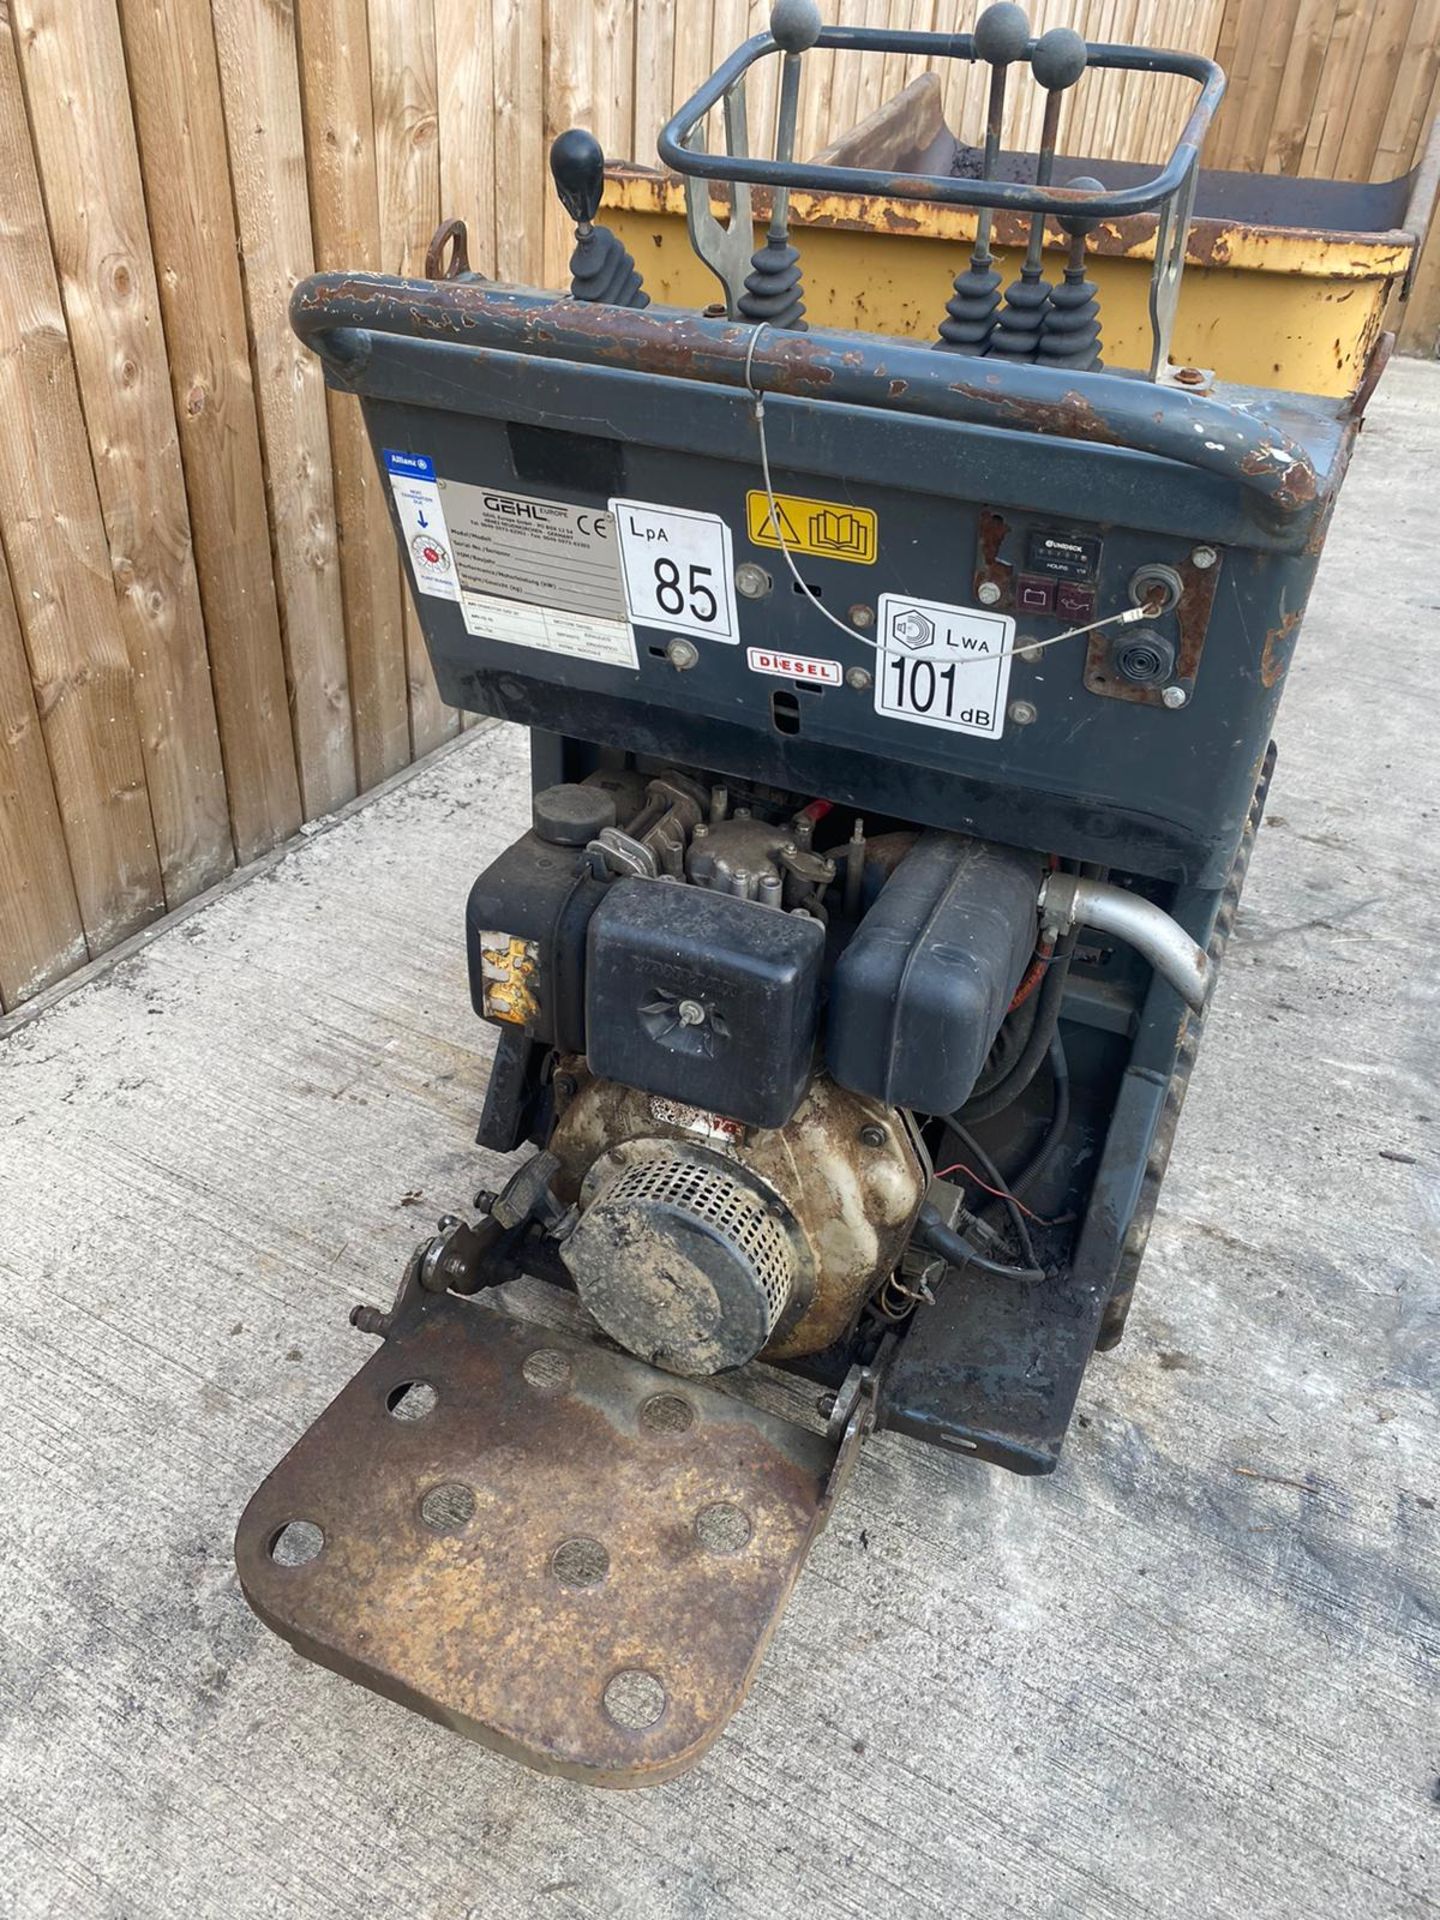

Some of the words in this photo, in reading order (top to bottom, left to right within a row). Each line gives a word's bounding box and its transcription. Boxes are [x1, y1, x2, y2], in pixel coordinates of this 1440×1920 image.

[391, 454, 417, 467] Allianz
[484, 496, 547, 521] GEHL
[539, 508, 568, 519] EUROPE
[577, 515, 607, 538] CE
[630, 516, 669, 542] LpA
[654, 557, 718, 622] 85
[947, 629, 990, 653] LWA
[760, 656, 830, 677] DIESEL
[891, 656, 958, 717] 101
[961, 708, 990, 726] dB
